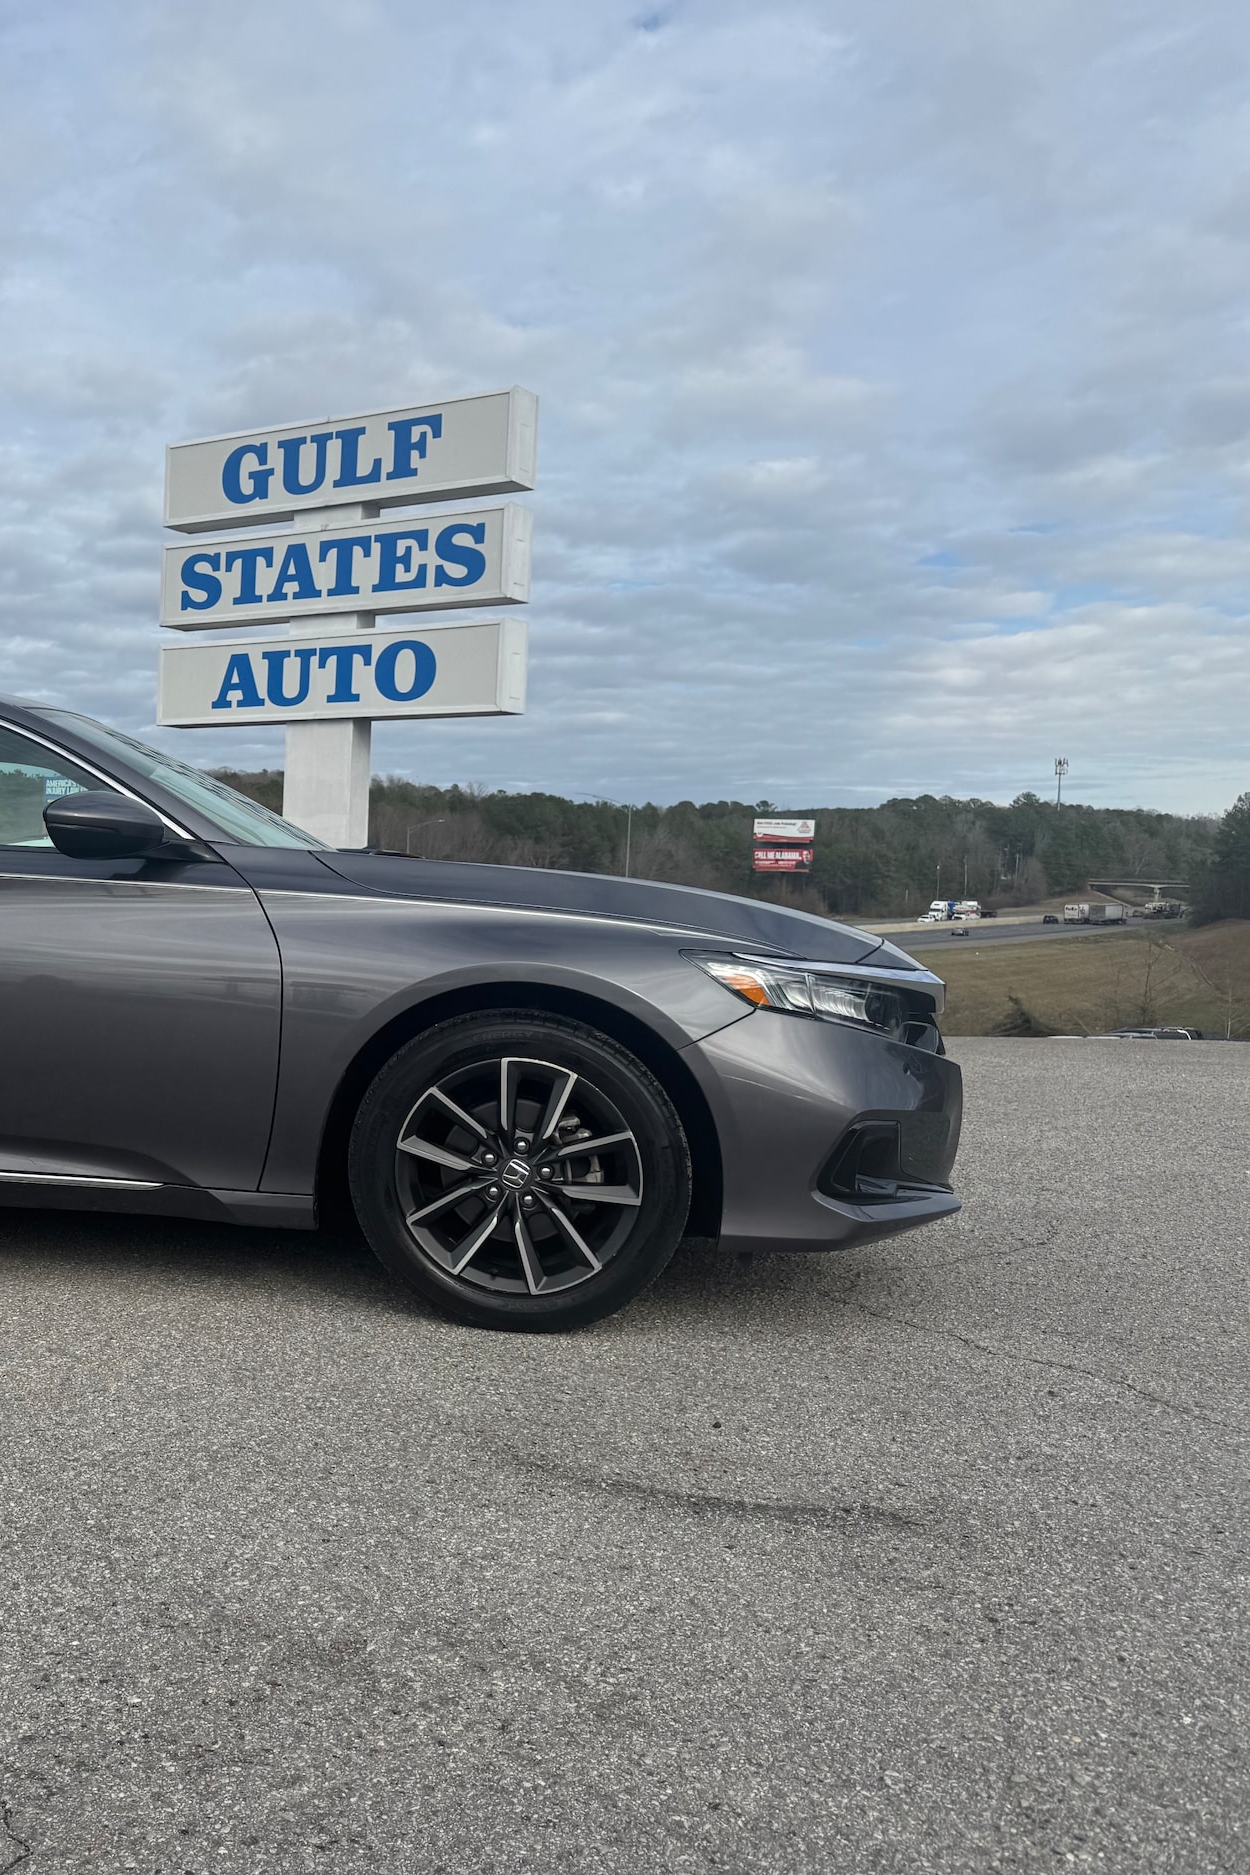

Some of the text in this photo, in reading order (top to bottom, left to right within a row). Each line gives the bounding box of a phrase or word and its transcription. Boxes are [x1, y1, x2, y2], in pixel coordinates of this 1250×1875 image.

[221, 413, 443, 504] GULF
[180, 522, 487, 611] STATES
[211, 639, 437, 709] AUTO
[472, 1030, 535, 1042] ENERGY
